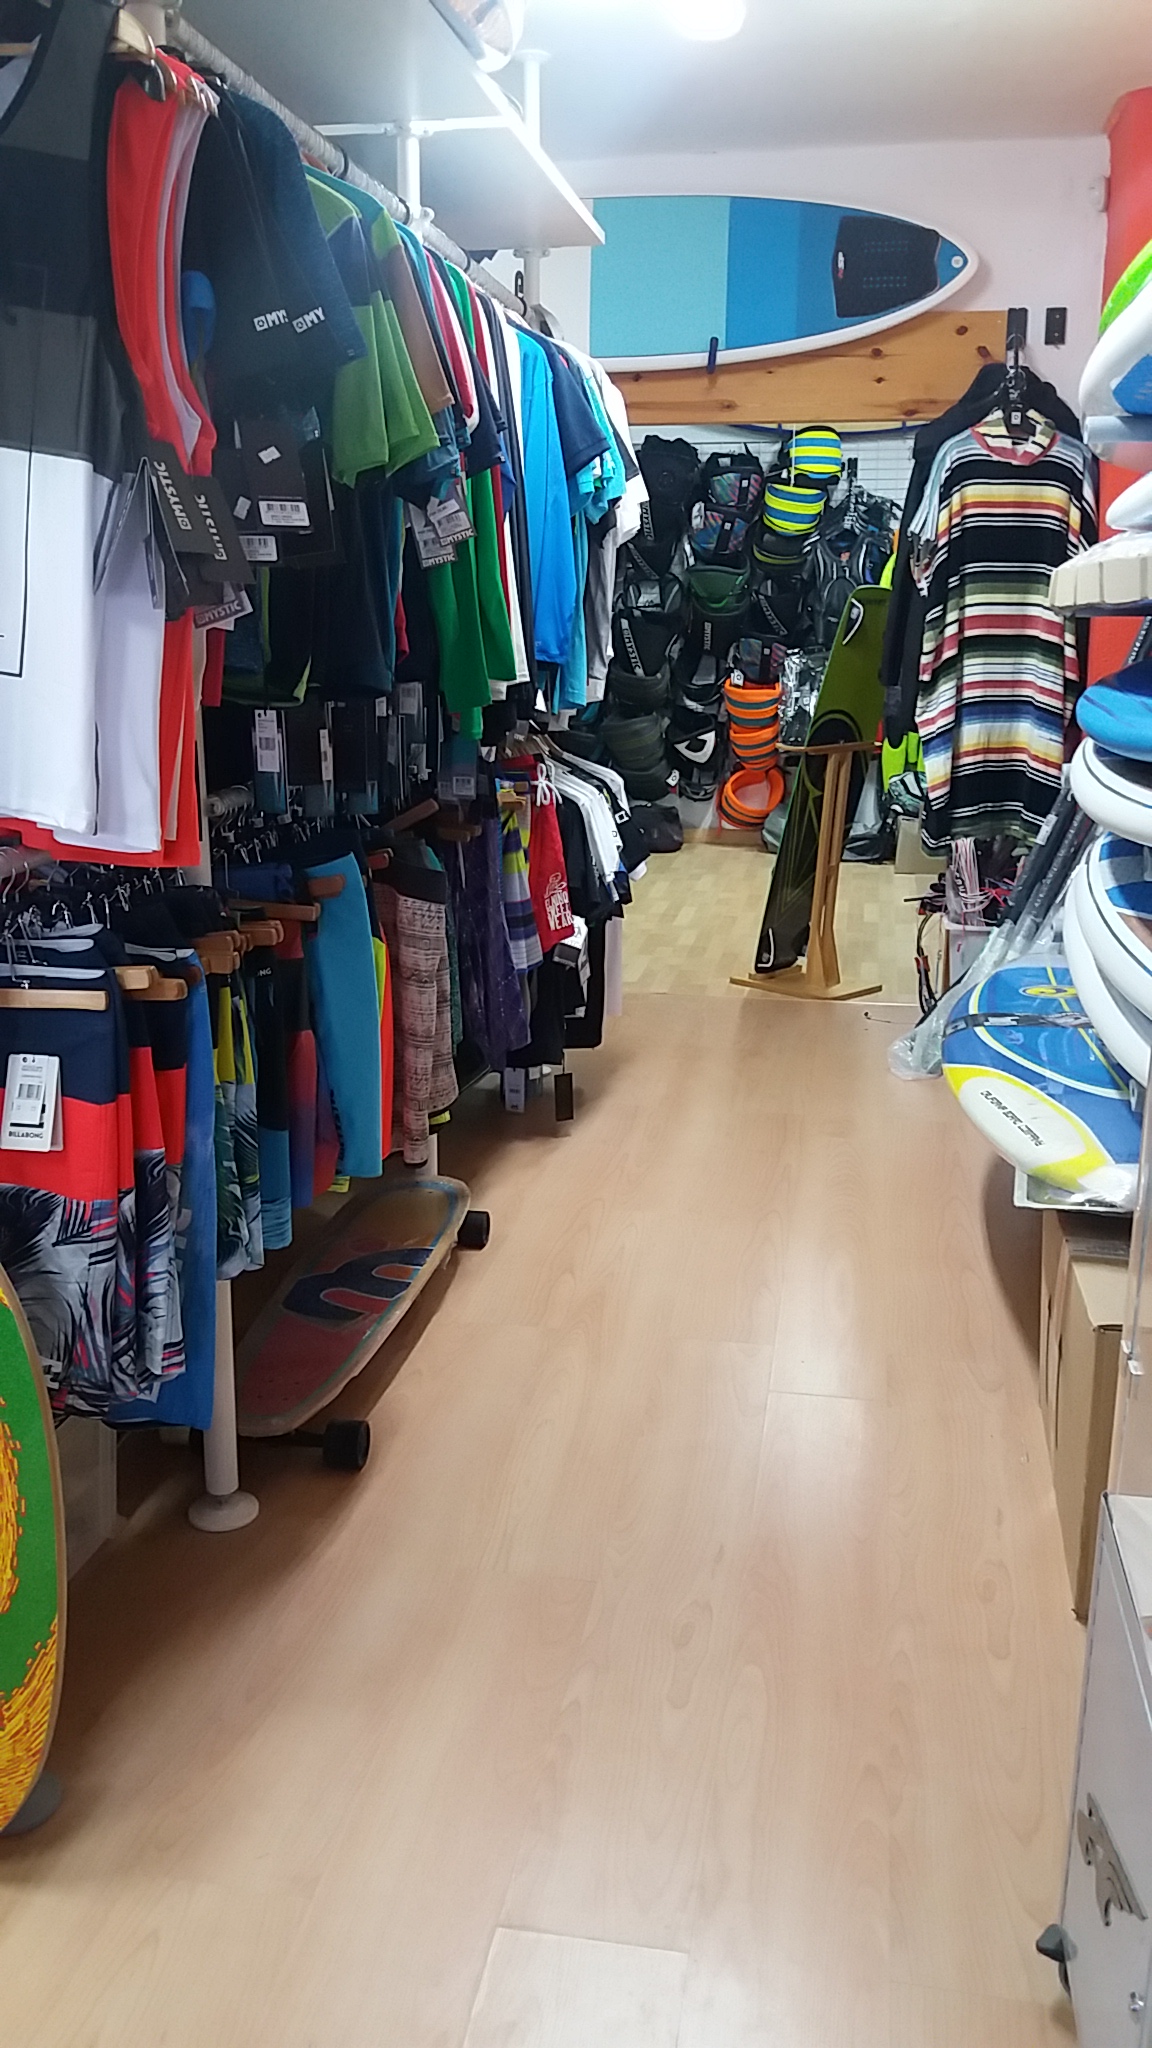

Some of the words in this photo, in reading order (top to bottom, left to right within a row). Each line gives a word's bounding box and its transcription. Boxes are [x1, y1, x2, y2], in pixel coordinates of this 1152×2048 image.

[154, 461, 186, 521] MYSTIC
[446, 528, 475, 545] MYSTIC
[429, 553, 456, 567] MYSTIC
[203, 600, 242, 622] MYSTIC
[624, 634, 641, 670] MYSTIC
[8, 1130, 44, 1140] BILLABONG
